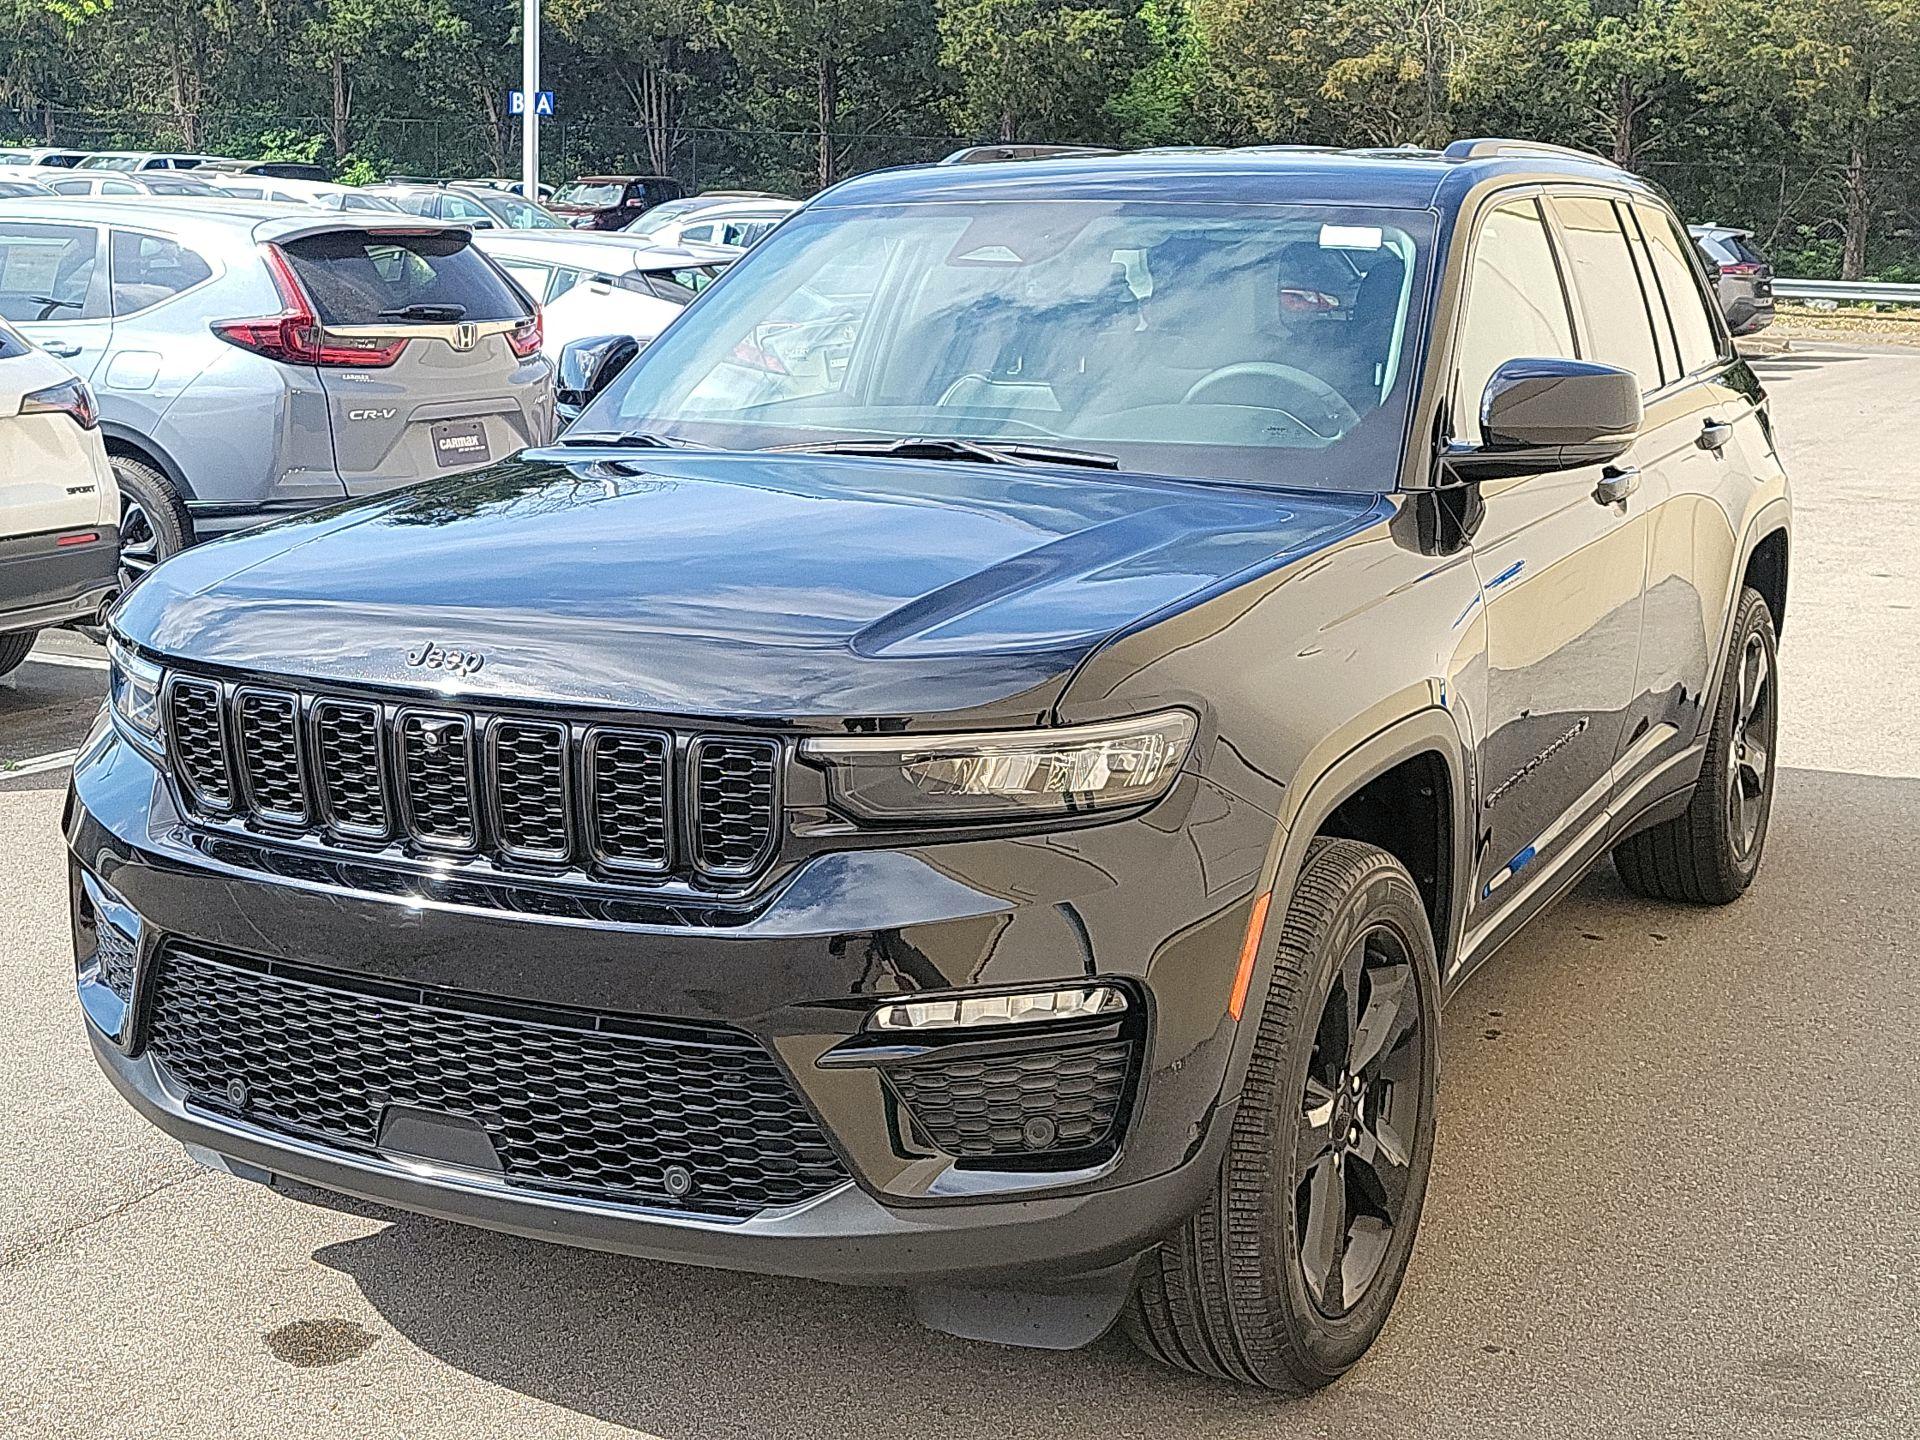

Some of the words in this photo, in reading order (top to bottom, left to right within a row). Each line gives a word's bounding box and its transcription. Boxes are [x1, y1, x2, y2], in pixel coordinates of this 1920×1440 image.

[536, 93, 553, 114] A
[350, 408, 397, 420] CR-V
[66, 485, 96, 495] SPORT
[406, 641, 485, 677] Jeep
